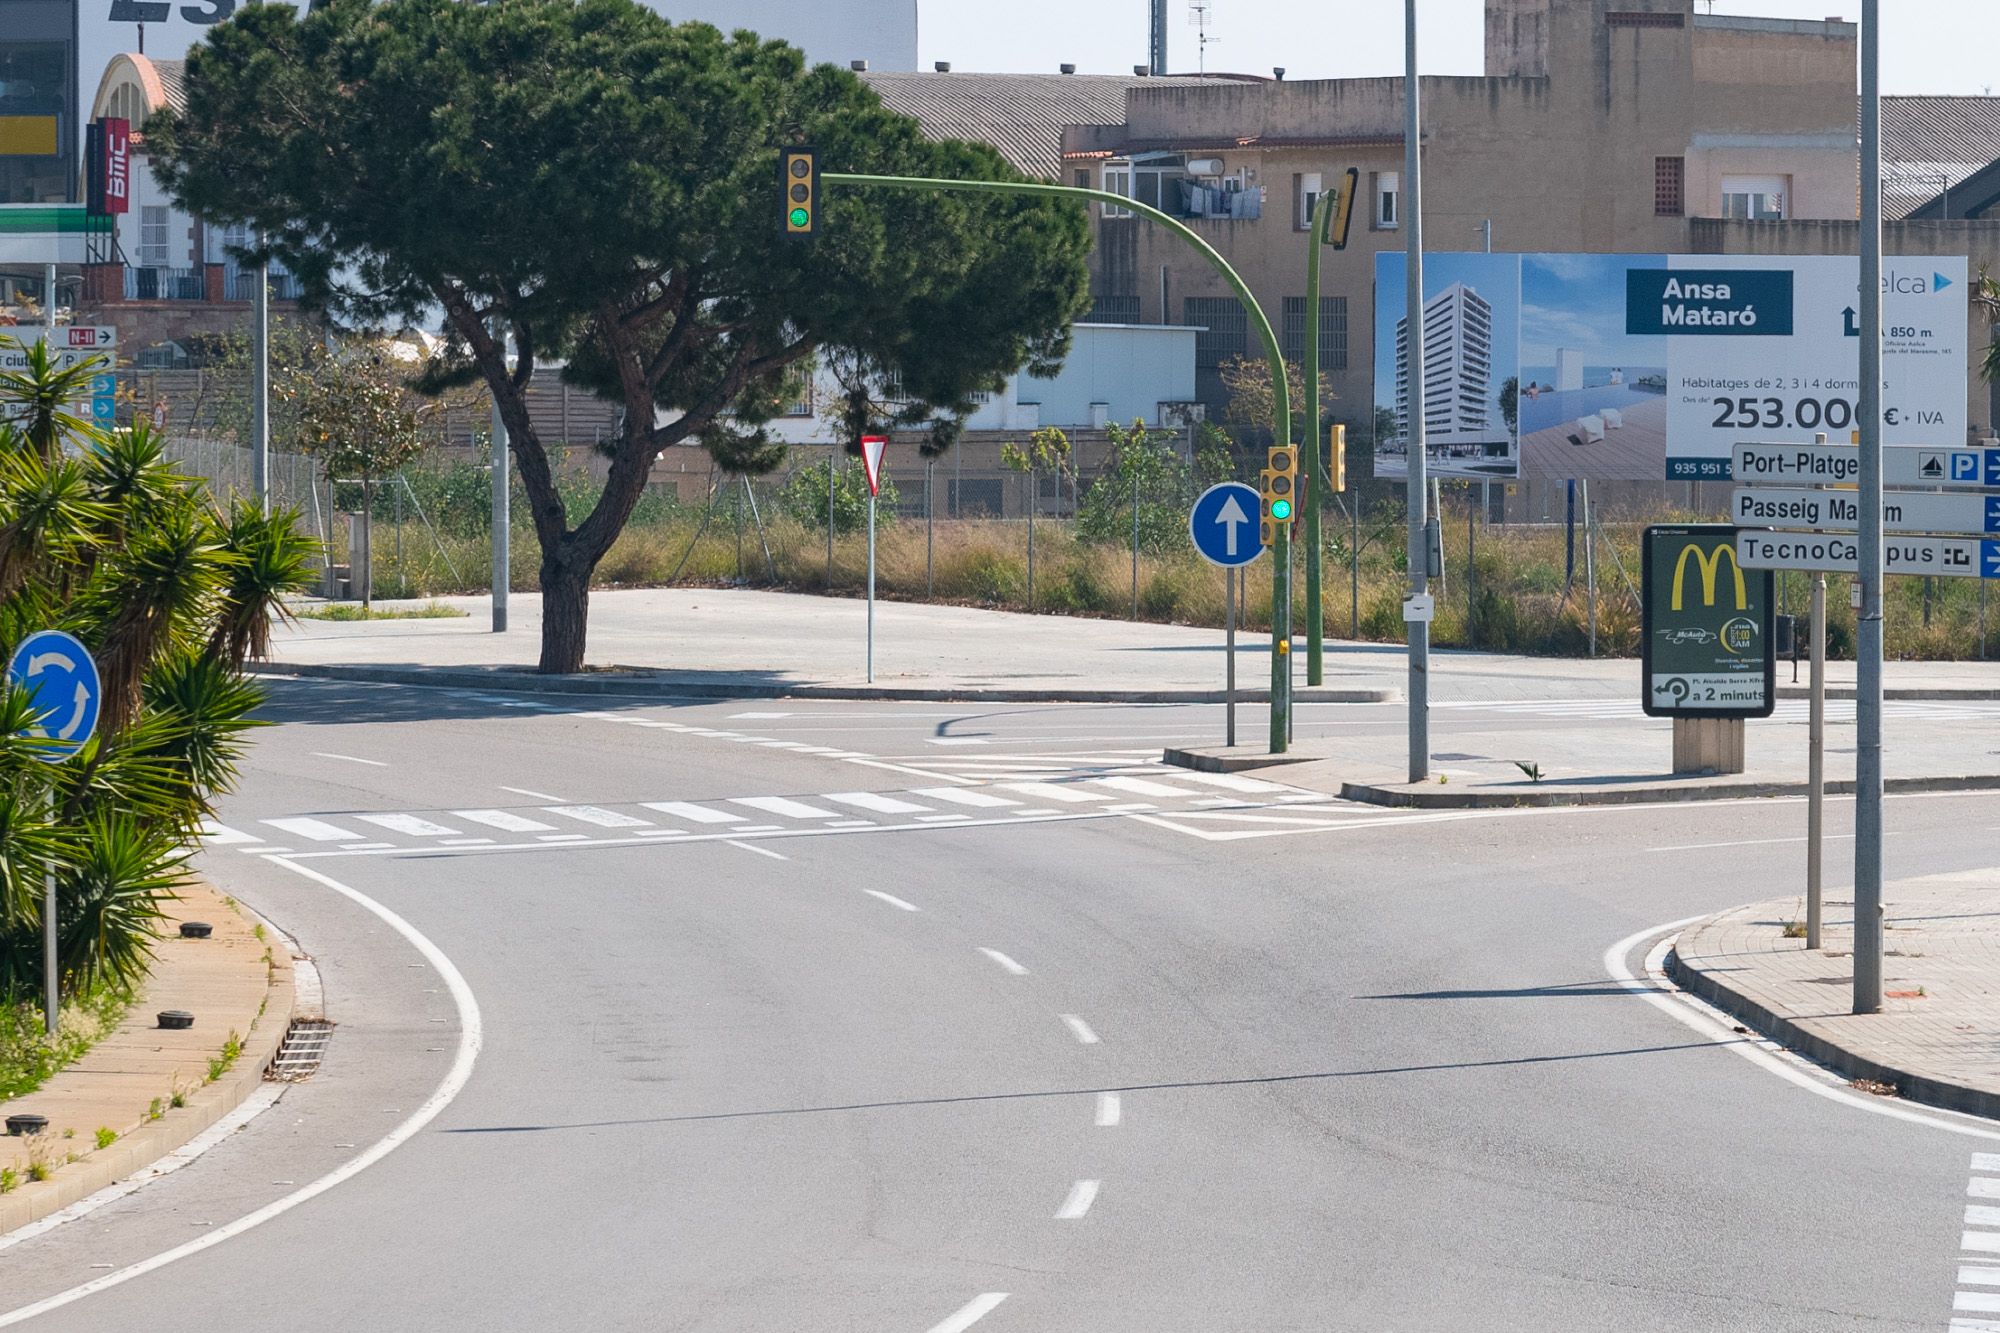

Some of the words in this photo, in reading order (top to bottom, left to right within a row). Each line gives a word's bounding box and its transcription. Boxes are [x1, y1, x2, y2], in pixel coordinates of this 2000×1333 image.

[1662, 278, 1731, 299] Ansa
[1857, 270, 1926, 294] elca
[1662, 304, 1757, 326] Mataró
[1891, 327, 1916, 337] 850
[6, 354, 29, 366] ciut
[1682, 377, 1749, 391] Habitatges
[1754, 378, 1771, 388] de
[1775, 378, 1786, 390] 2,
[1791, 378, 1800, 389] 3
[1804, 378, 1807, 389] i
[1812, 378, 1820, 388] 4
[1883, 407, 1899, 426] €
[1917, 411, 1944, 424] IVA
[1674, 463, 1697, 474] 935
[1701, 463, 1720, 474] 951
[1742, 451, 1859, 479] Port-Platge
[1741, 496, 1820, 524] Passeig
[1744, 539, 1933, 566] TecnoCapus
[1693, 692, 1701, 701] a
[1705, 687, 1716, 701] 2
[1720, 690, 1765, 700] minuts
